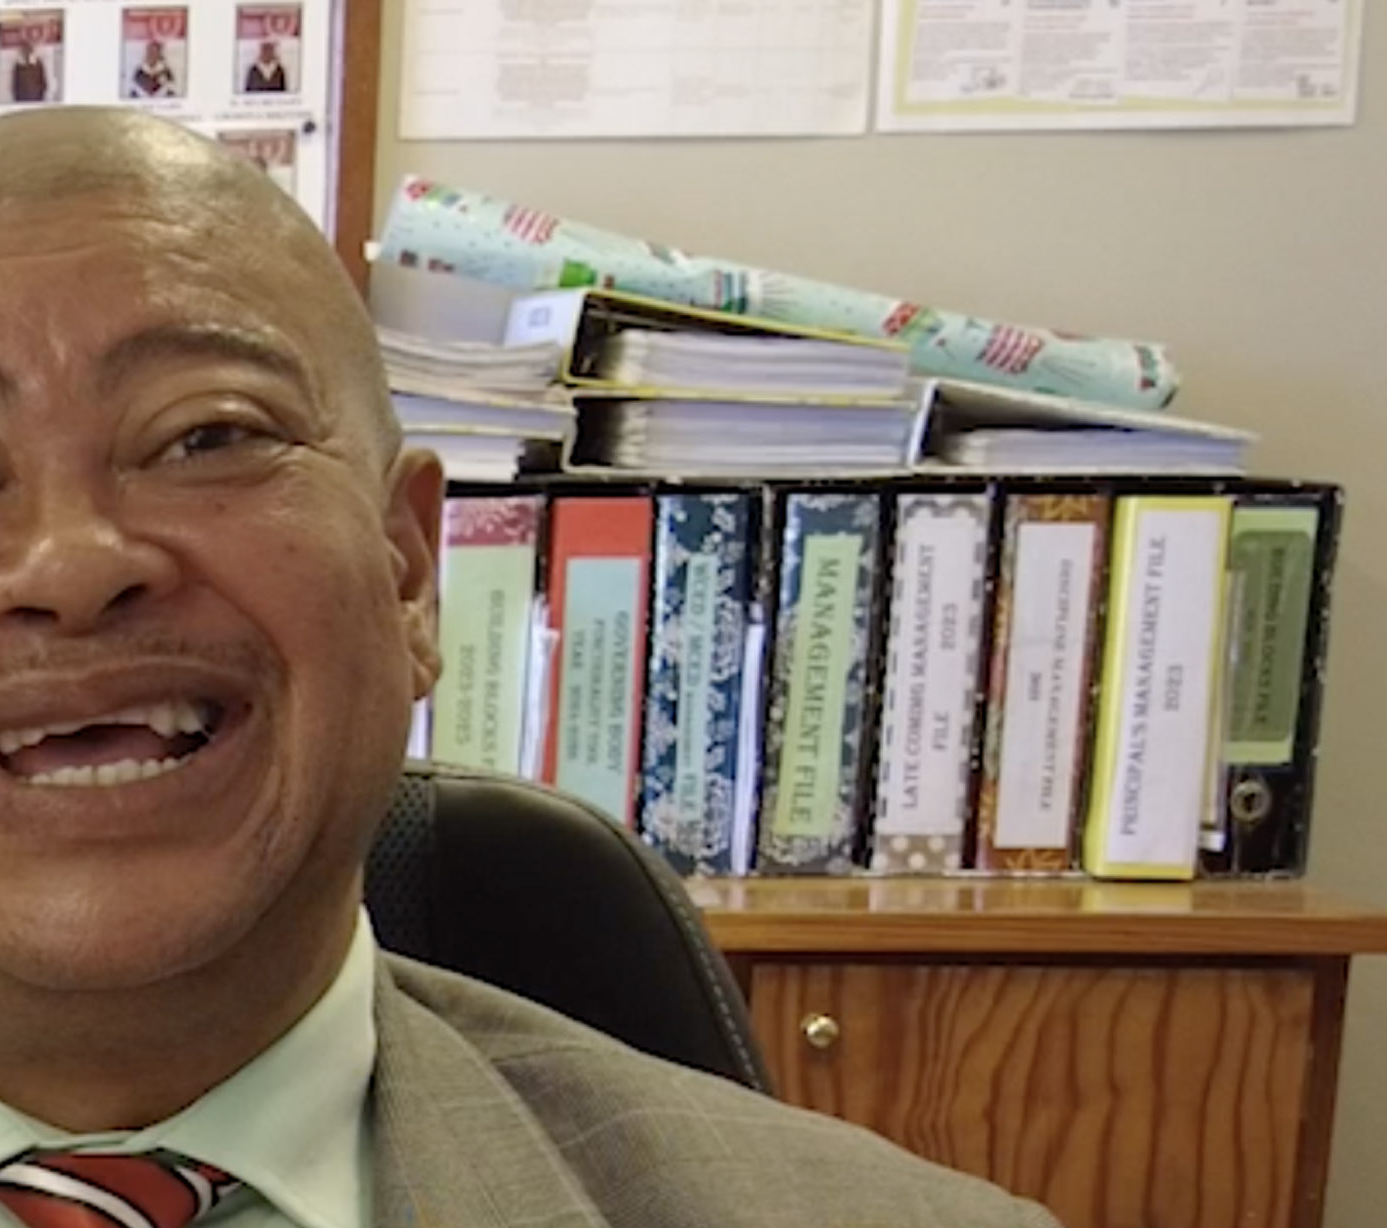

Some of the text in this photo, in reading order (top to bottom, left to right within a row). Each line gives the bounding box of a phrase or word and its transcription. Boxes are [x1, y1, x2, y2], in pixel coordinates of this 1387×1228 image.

[790, 557, 842, 824] MANAGEMENT FILE
[902, 544, 936, 809] LATE COMING MANAGEMENT
[932, 711, 950, 752] FILE
[1120, 536, 1166, 836] PRINCIPAL'S MANAGEMENT FILE
[1163, 663, 1184, 712] 2023
